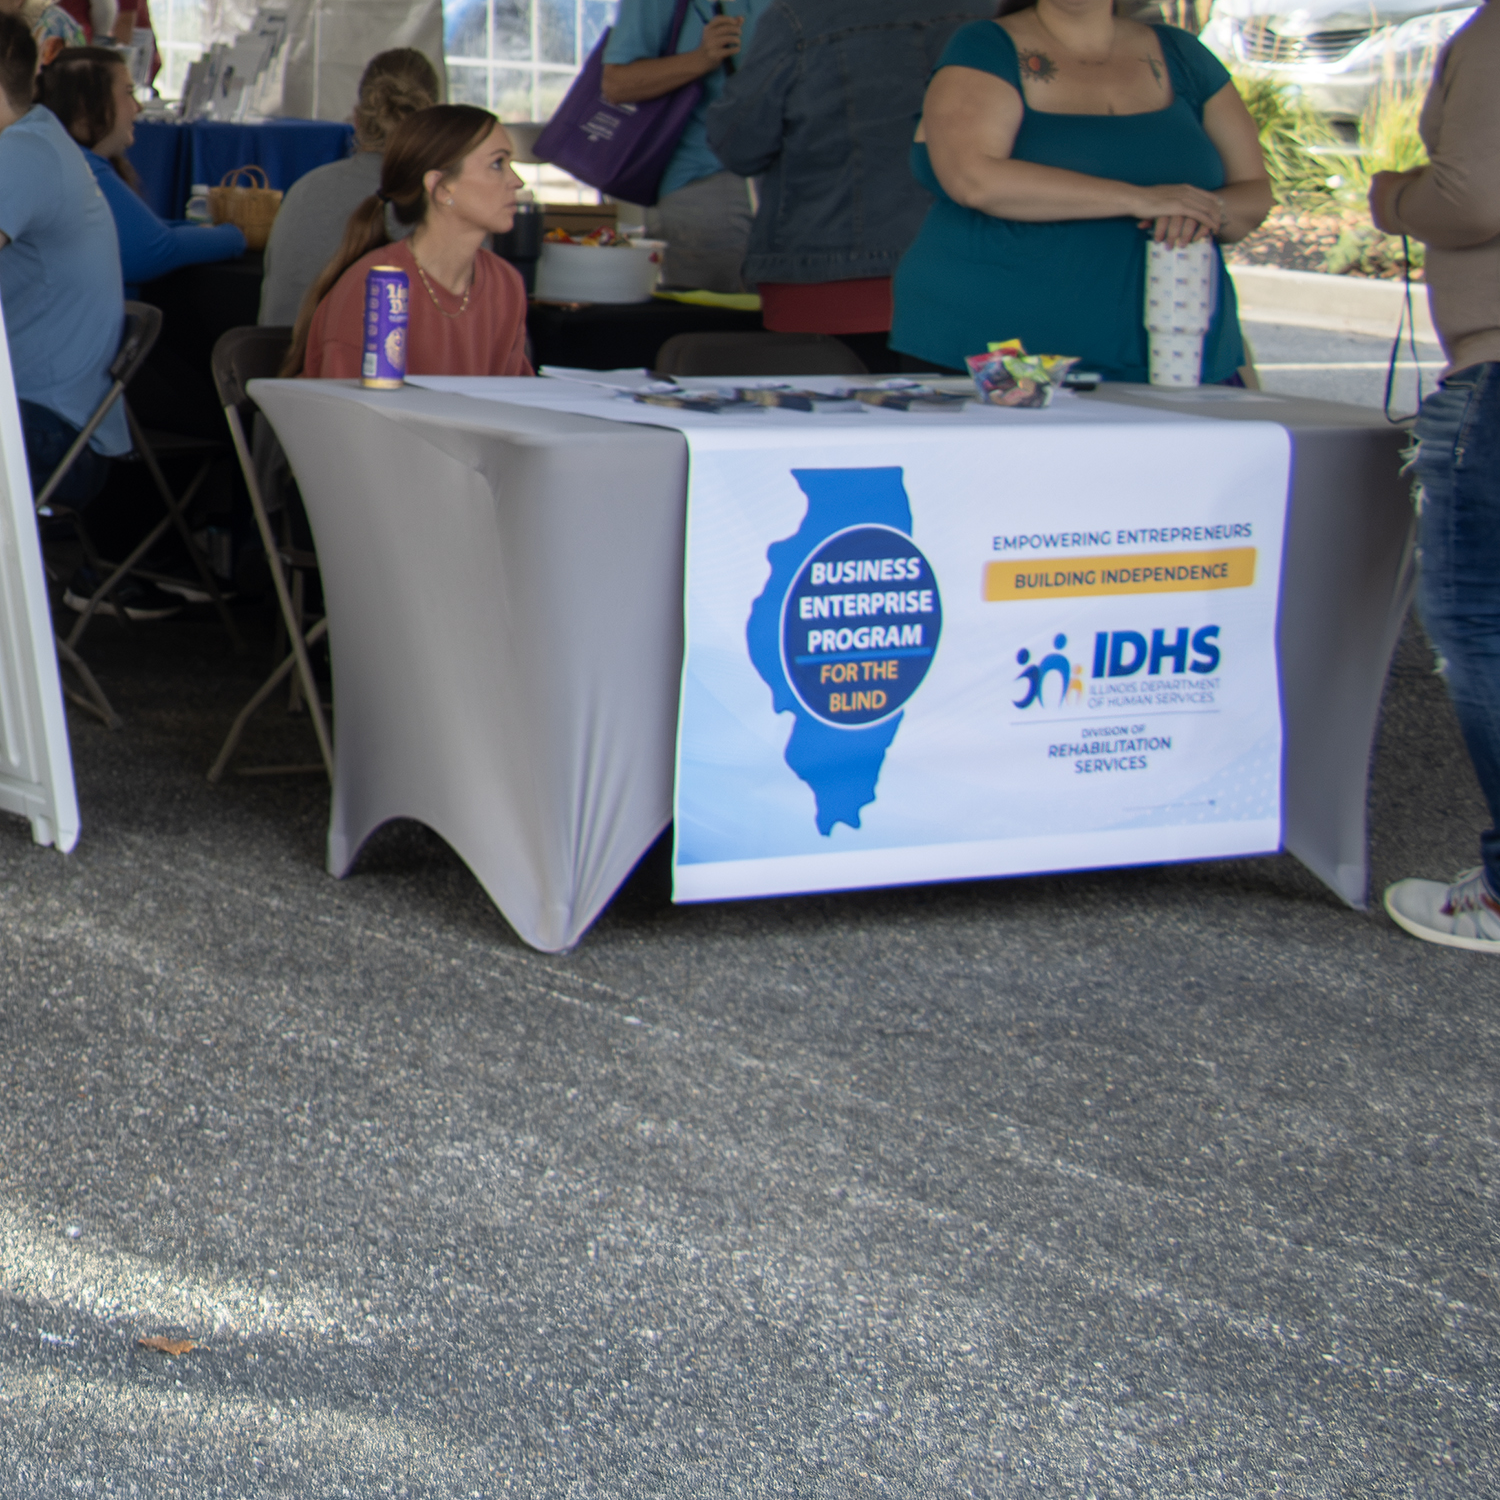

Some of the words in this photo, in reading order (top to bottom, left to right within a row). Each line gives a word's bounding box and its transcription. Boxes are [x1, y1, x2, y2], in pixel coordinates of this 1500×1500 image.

[992, 530, 1112, 551] EMPOWERING
[1116, 522, 1253, 545] ENTREPRENEURS
[810, 557, 921, 585] BUSINESS
[1014, 570, 1096, 589] BUILDING
[1100, 563, 1229, 585] INDEPENDENCE
[799, 590, 933, 620] ENTERPRISE
[807, 624, 923, 653] PROGRAM
[1091, 624, 1221, 679] IDHS
[820, 663, 859, 684] FOR
[861, 660, 899, 681] THE
[1089, 683, 1138, 696] ILLINOIS
[1140, 677, 1220, 693] DEPARTMENT
[829, 690, 887, 713] BLIND
[1087, 697, 1104, 709] OF
[1107, 695, 1152, 708] HUMAN
[1155, 691, 1215, 705] SERVICES
[1081, 727, 1129, 740] DIVISION
[1130, 724, 1146, 736] OF
[1048, 736, 1172, 759] REHABILITATION
[1073, 755, 1147, 774] SERVICES
